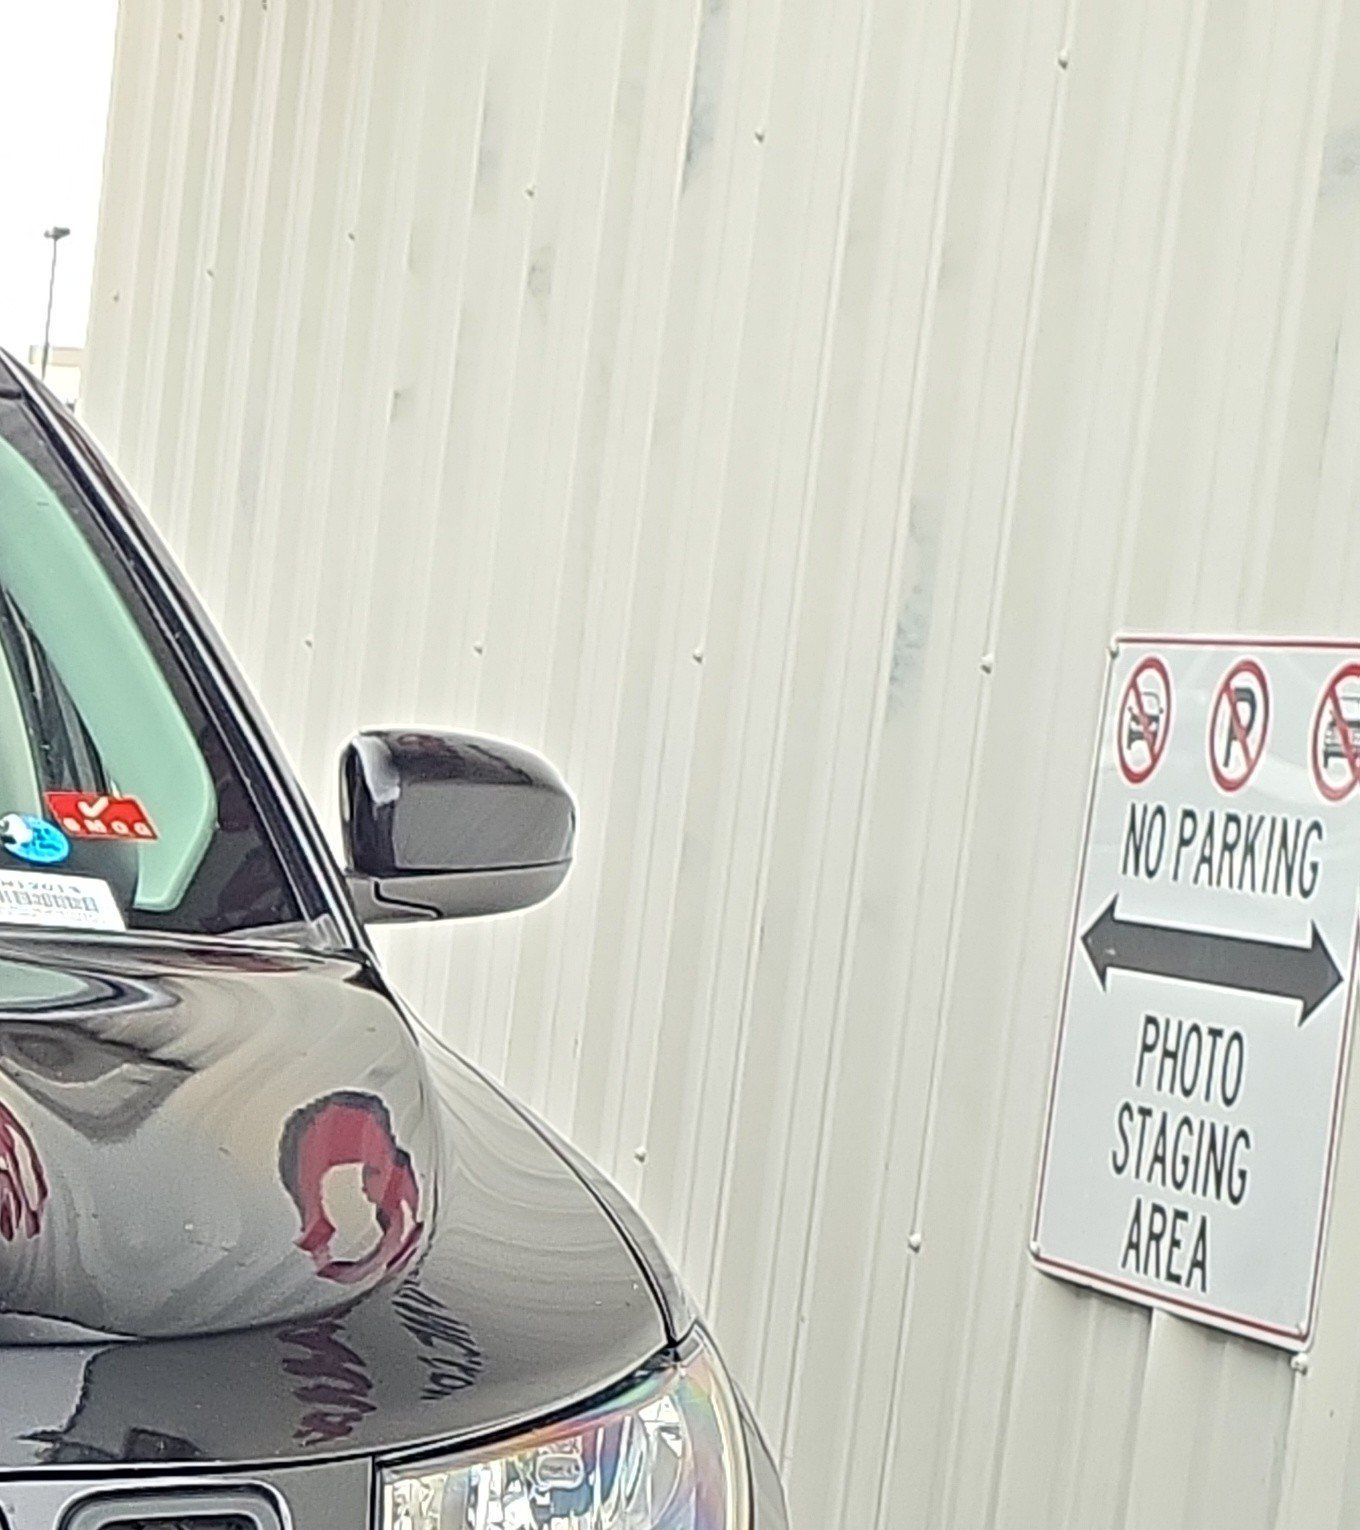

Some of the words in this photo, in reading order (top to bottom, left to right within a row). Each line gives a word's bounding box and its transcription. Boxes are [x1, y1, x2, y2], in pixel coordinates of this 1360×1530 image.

[1122, 803, 1166, 879] NO
[1172, 808, 1323, 899] PARKING
[1136, 1014, 1244, 1107] PHOTO
[1112, 1102, 1251, 1206] STAGING
[1121, 1197, 1207, 1293] AREA
